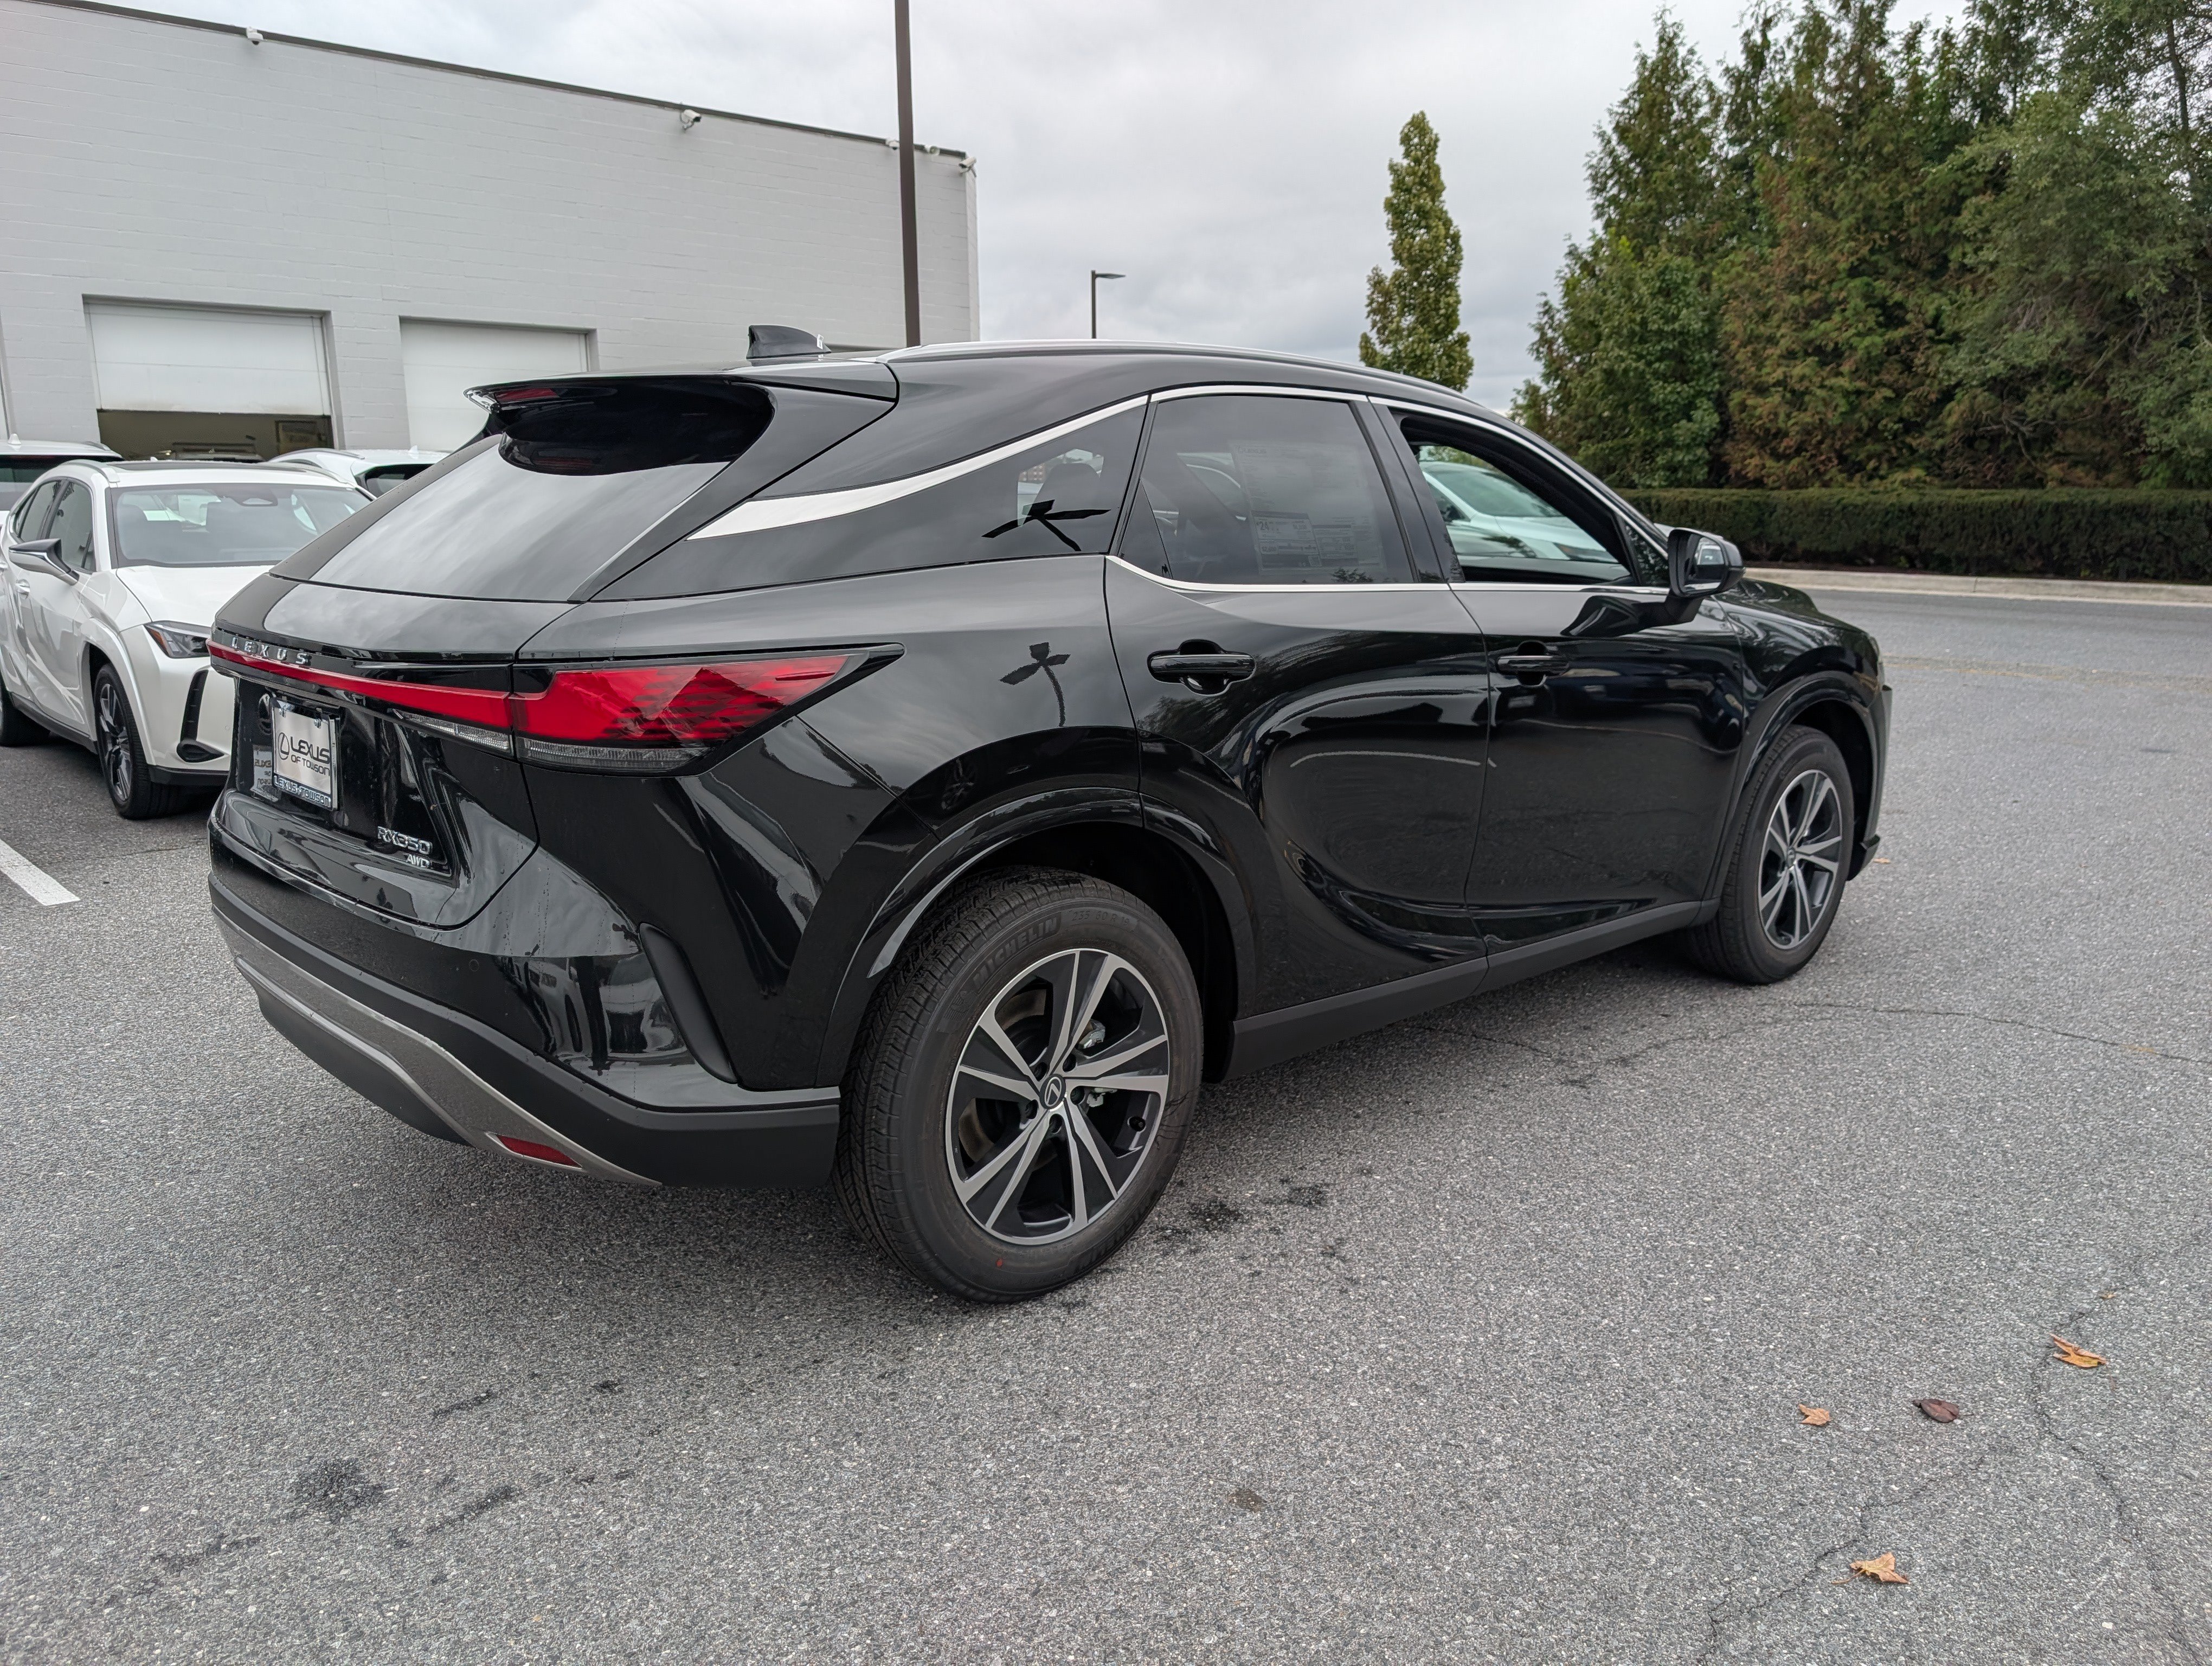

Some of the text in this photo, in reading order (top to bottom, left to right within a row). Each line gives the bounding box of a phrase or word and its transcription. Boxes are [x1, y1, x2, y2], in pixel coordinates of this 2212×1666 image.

[231, 637, 308, 665] LEXUS
[290, 736, 331, 764] LEXUS
[291, 754, 330, 776] OF TOWSON
[273, 775, 331, 808] LEXUS TOWSON
[406, 854, 430, 868] AWD
[973, 916, 1057, 986] MICHELIN
